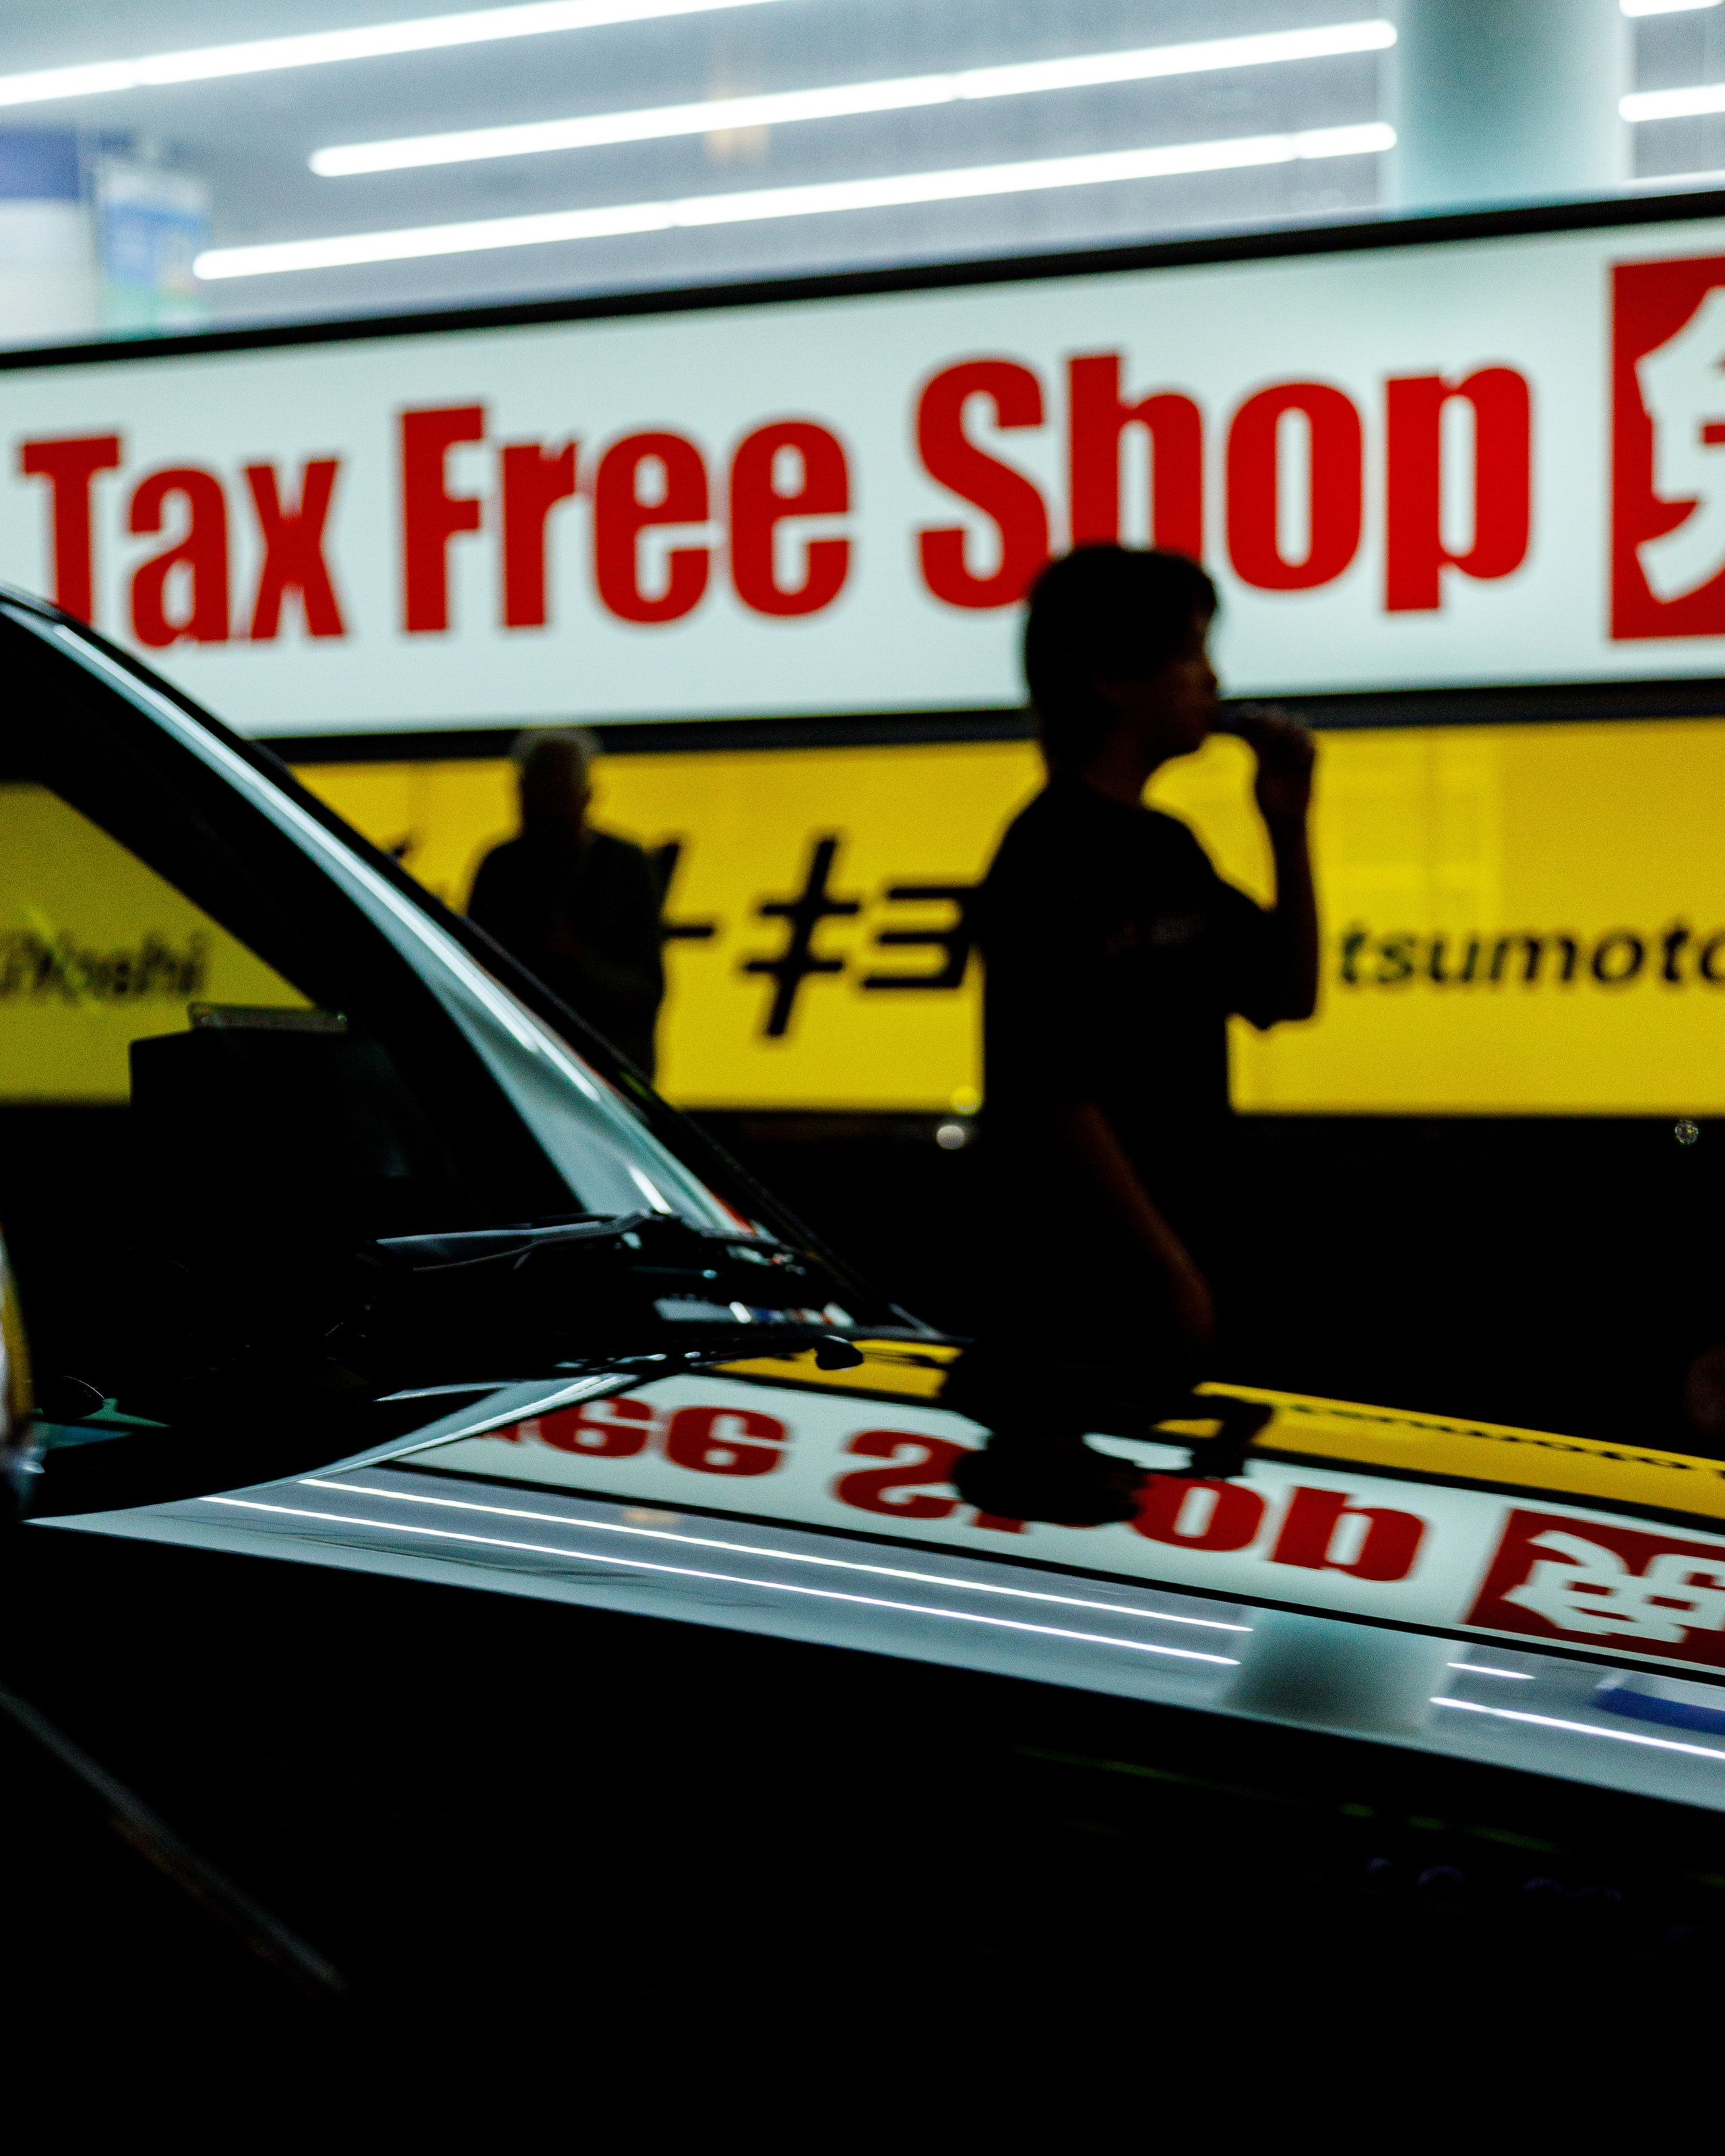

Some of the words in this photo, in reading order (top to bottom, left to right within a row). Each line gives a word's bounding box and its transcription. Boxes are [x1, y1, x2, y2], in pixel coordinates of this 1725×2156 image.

[19, 433, 345, 650] Tax
[400, 405, 851, 634] Free
[914, 348, 1532, 614] Shop
